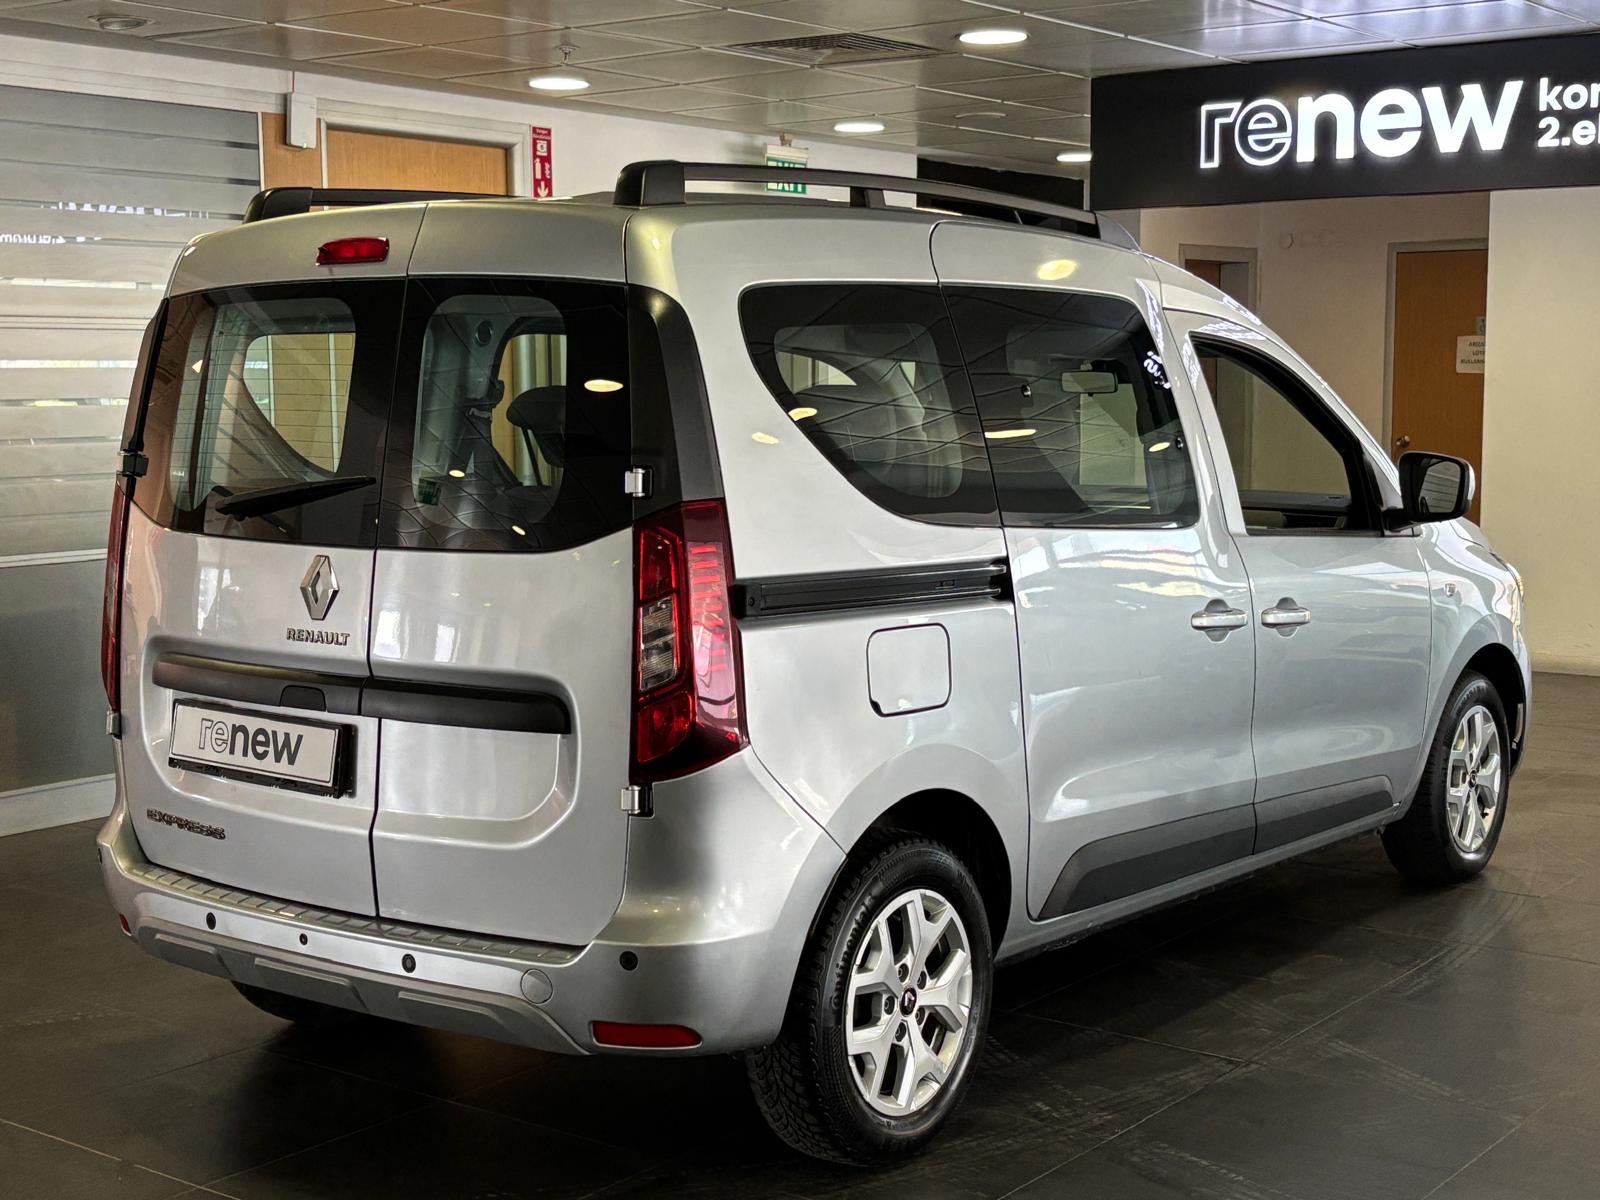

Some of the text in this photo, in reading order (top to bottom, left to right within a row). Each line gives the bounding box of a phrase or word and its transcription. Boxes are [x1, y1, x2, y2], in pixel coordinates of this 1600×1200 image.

[1200, 79, 1524, 169] renew
[286, 628, 350, 646] RENAULT
[199, 718, 304, 766] renew
